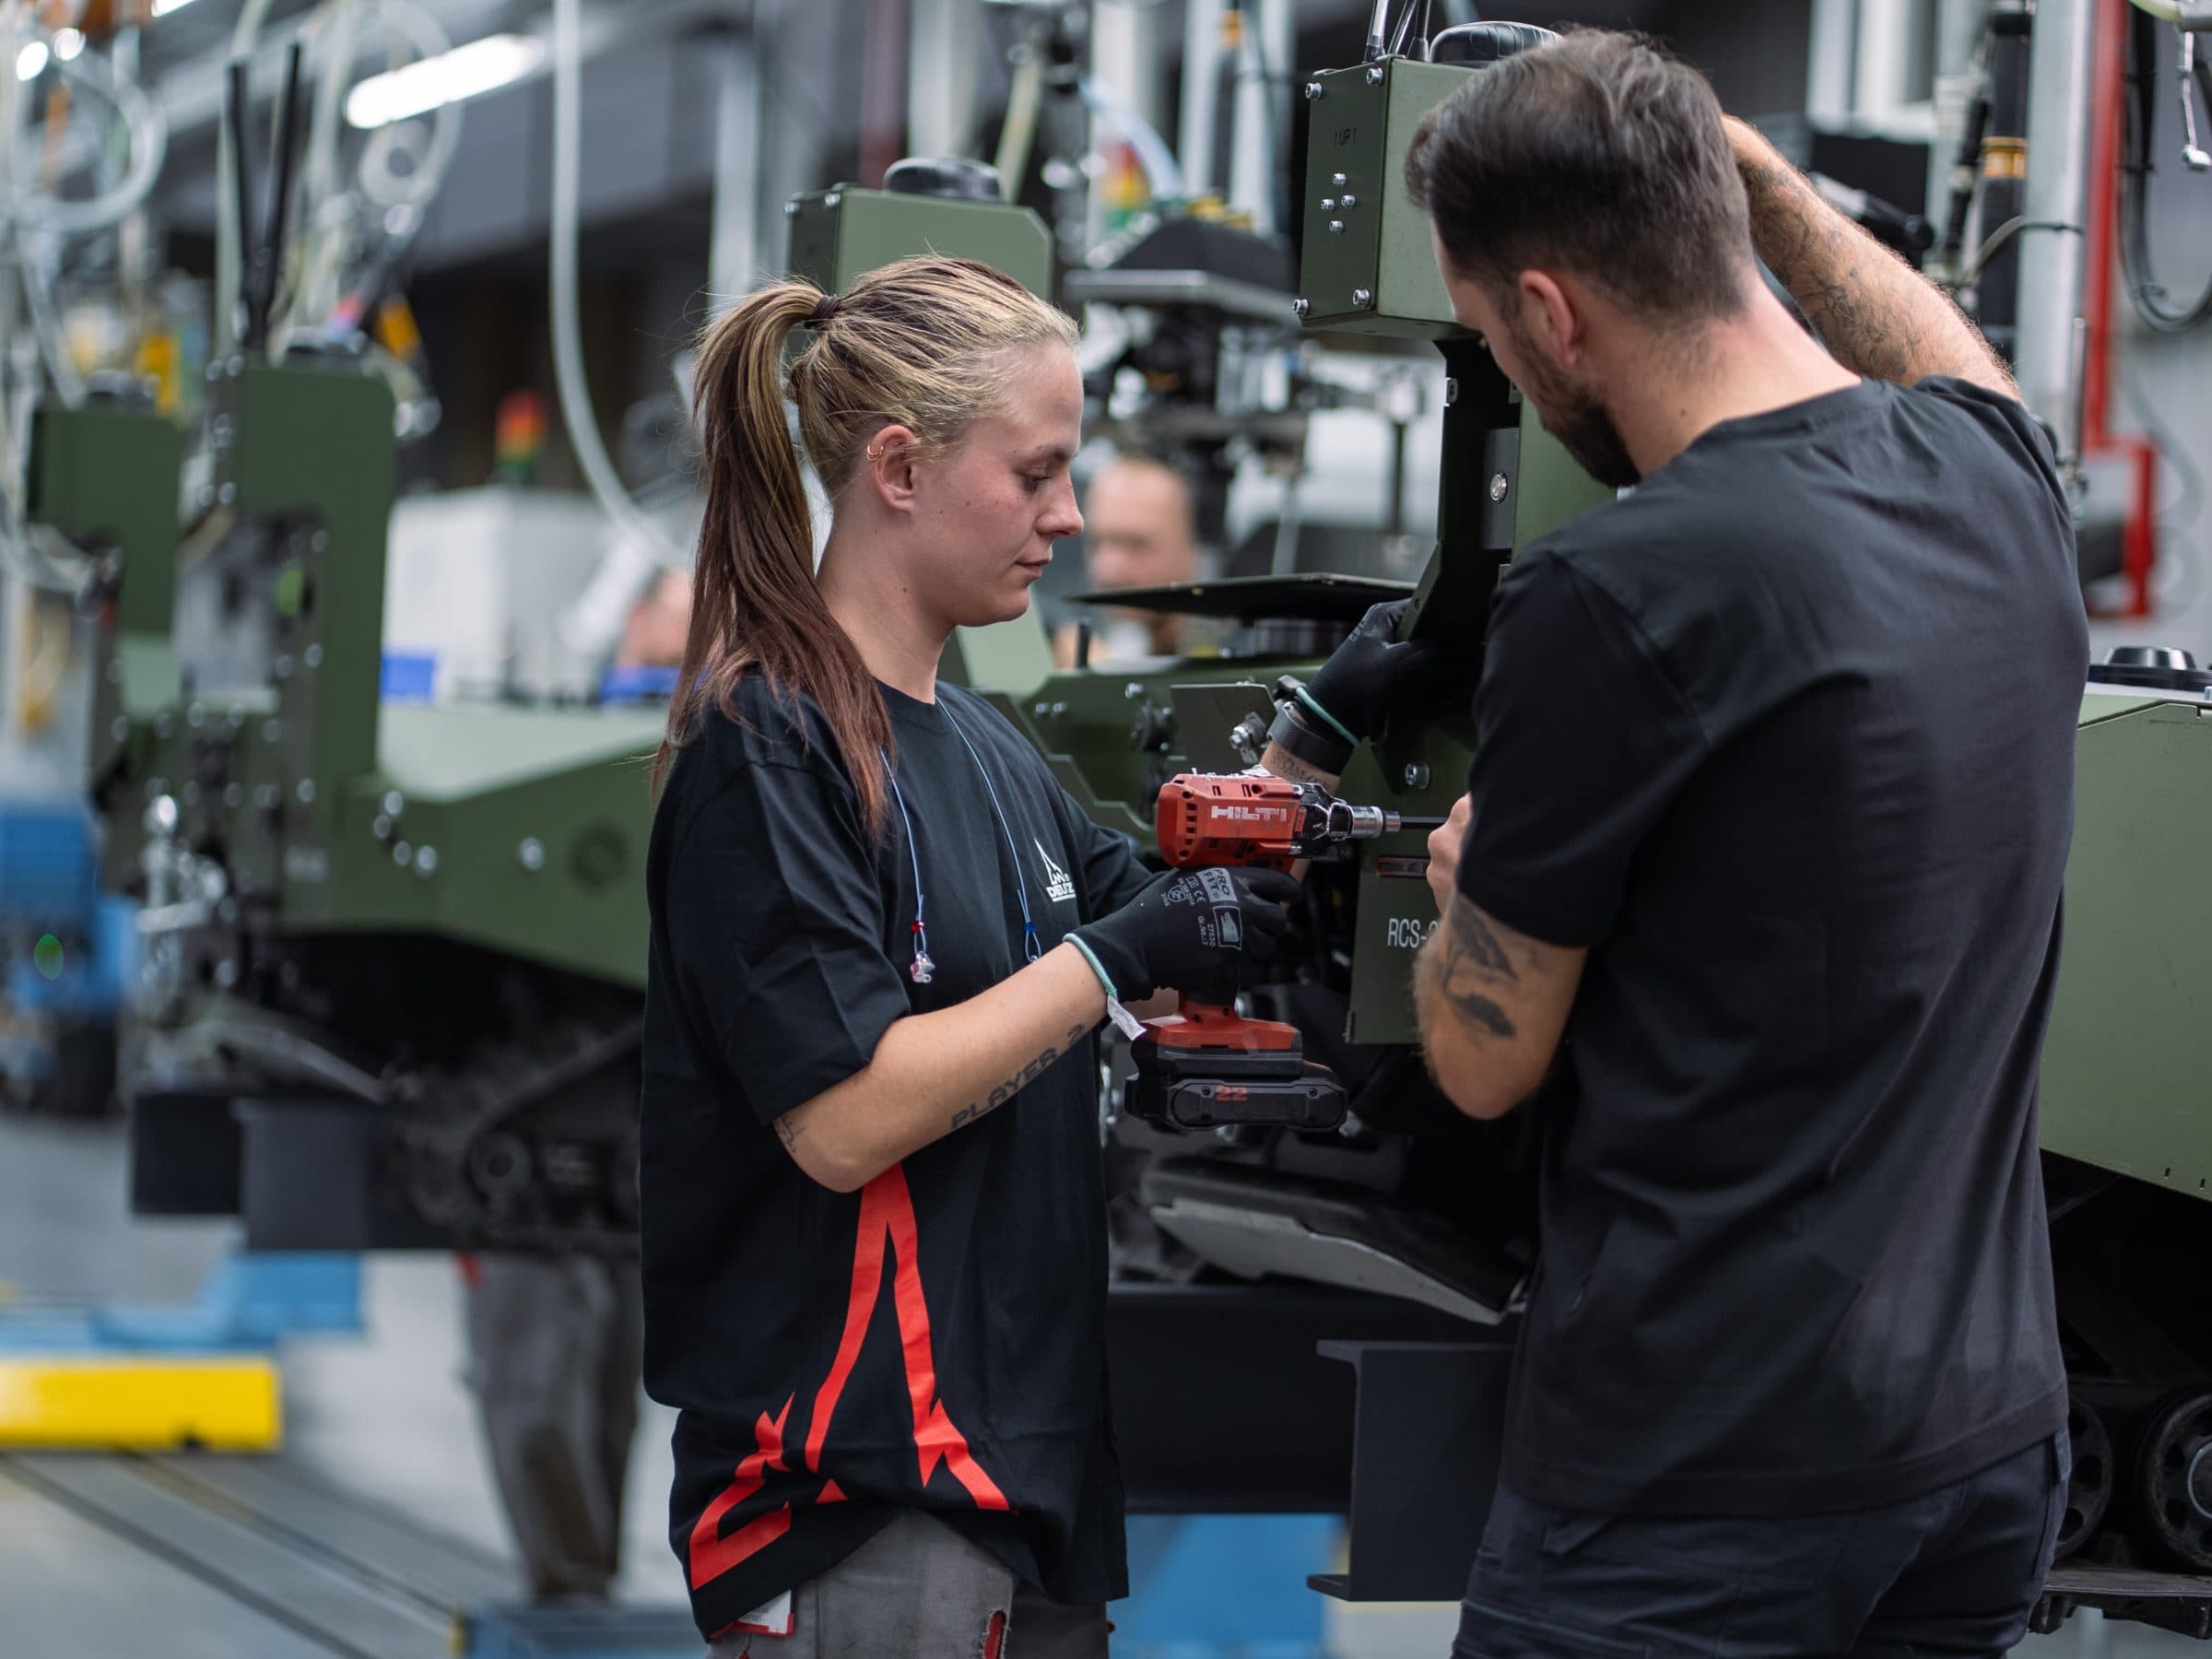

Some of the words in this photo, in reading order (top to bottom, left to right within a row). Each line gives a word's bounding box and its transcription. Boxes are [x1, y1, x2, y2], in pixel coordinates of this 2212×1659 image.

[1211, 806, 1287, 821] HILTI
[1213, 869, 1230, 896] PRO
[951, 1047, 1058, 1128] PLAYER
[1216, 1085, 1247, 1101] 22
